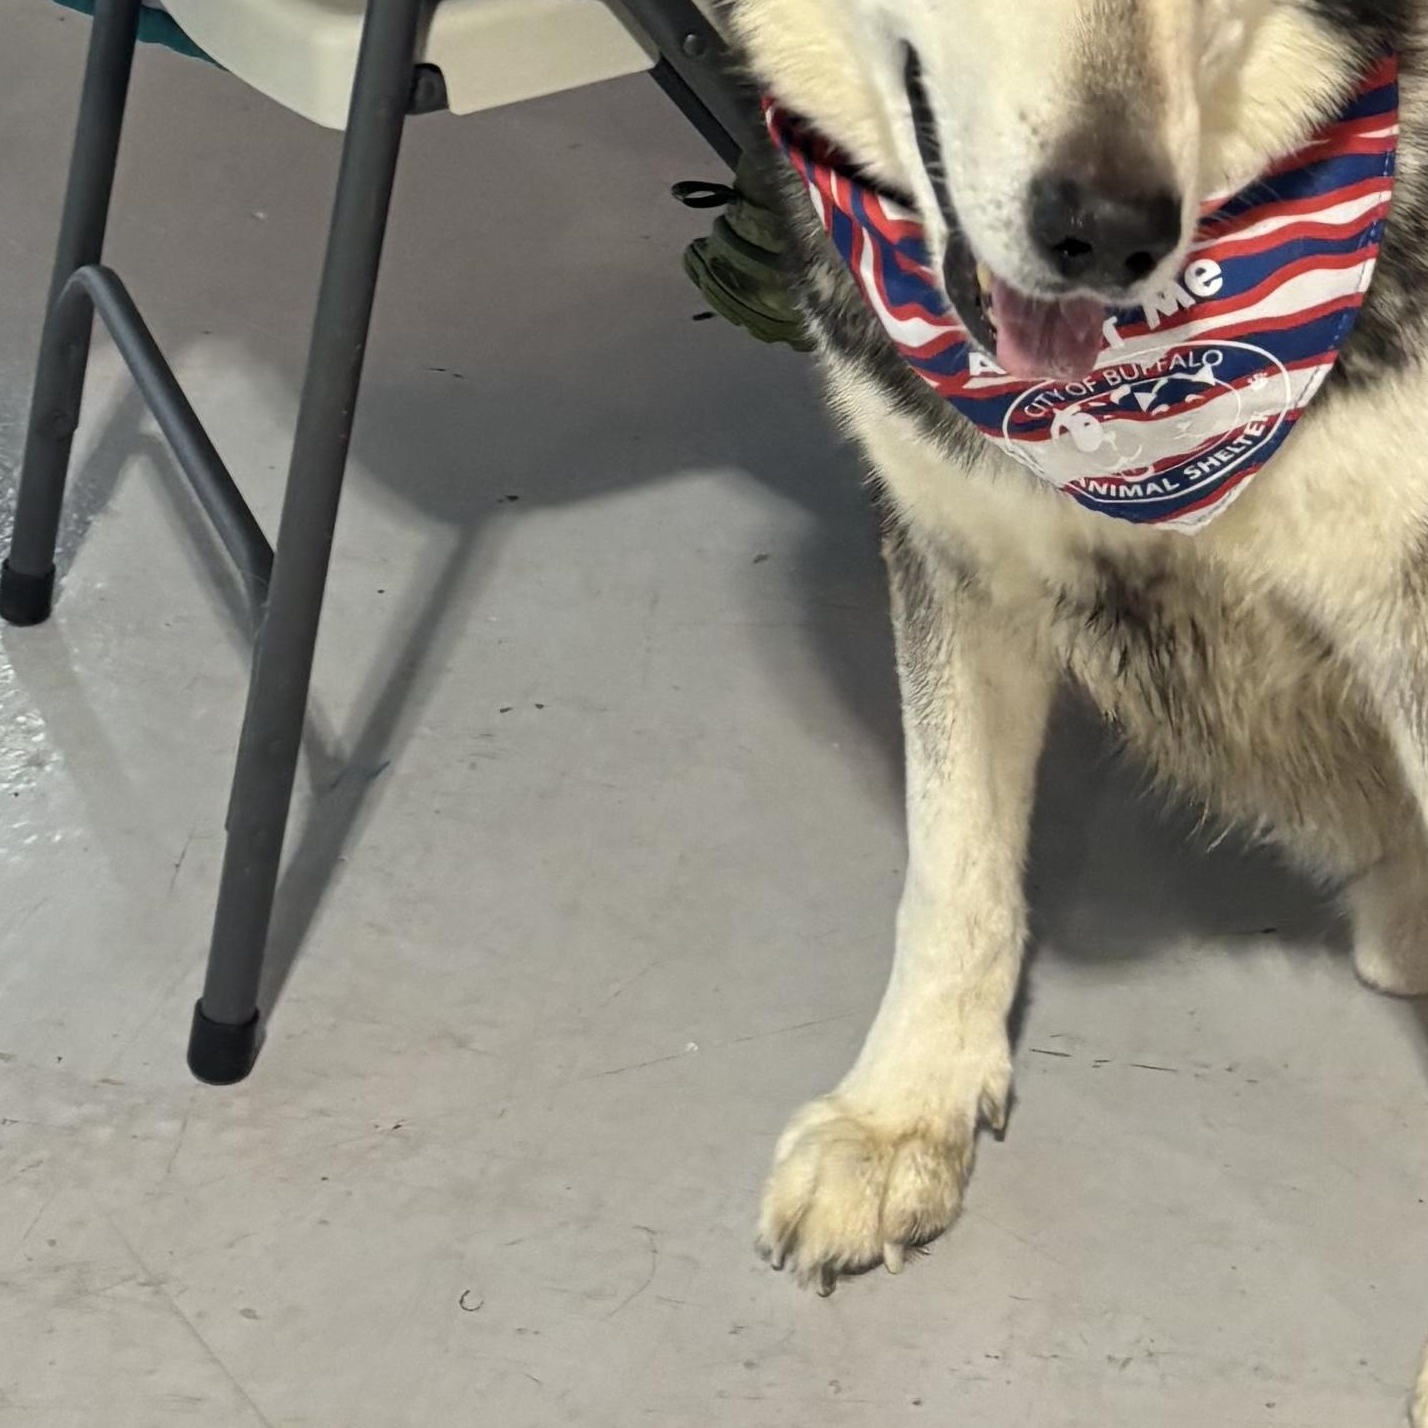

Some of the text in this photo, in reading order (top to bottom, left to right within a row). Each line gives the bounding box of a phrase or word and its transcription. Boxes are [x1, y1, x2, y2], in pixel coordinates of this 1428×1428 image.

[1143, 258, 1224, 331] Me
[1023, 349, 1224, 418] CITY OF BUFFALO
